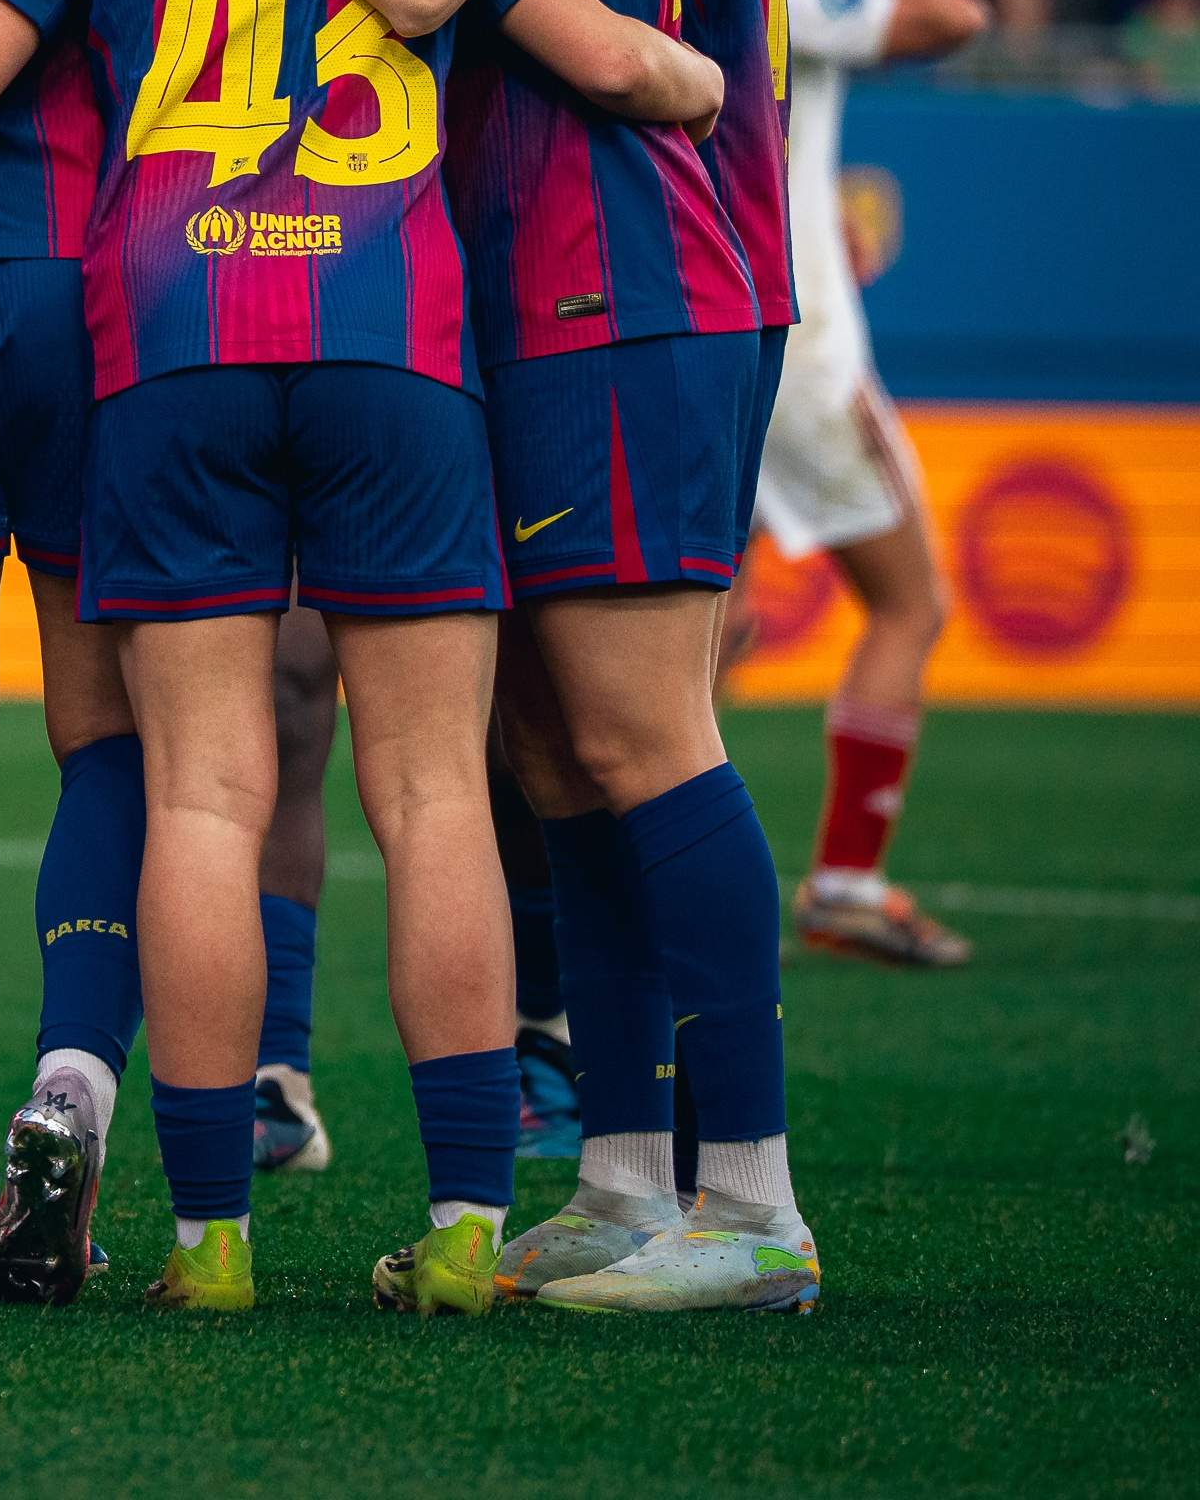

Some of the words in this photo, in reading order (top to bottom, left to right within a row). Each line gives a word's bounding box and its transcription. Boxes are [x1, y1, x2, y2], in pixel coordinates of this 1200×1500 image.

[250, 211, 341, 232] UNHCR
[249, 231, 342, 249] ACNUR
[250, 249, 266, 257] The
[280, 249, 312, 257] Refugee
[313, 247, 342, 256] Agency
